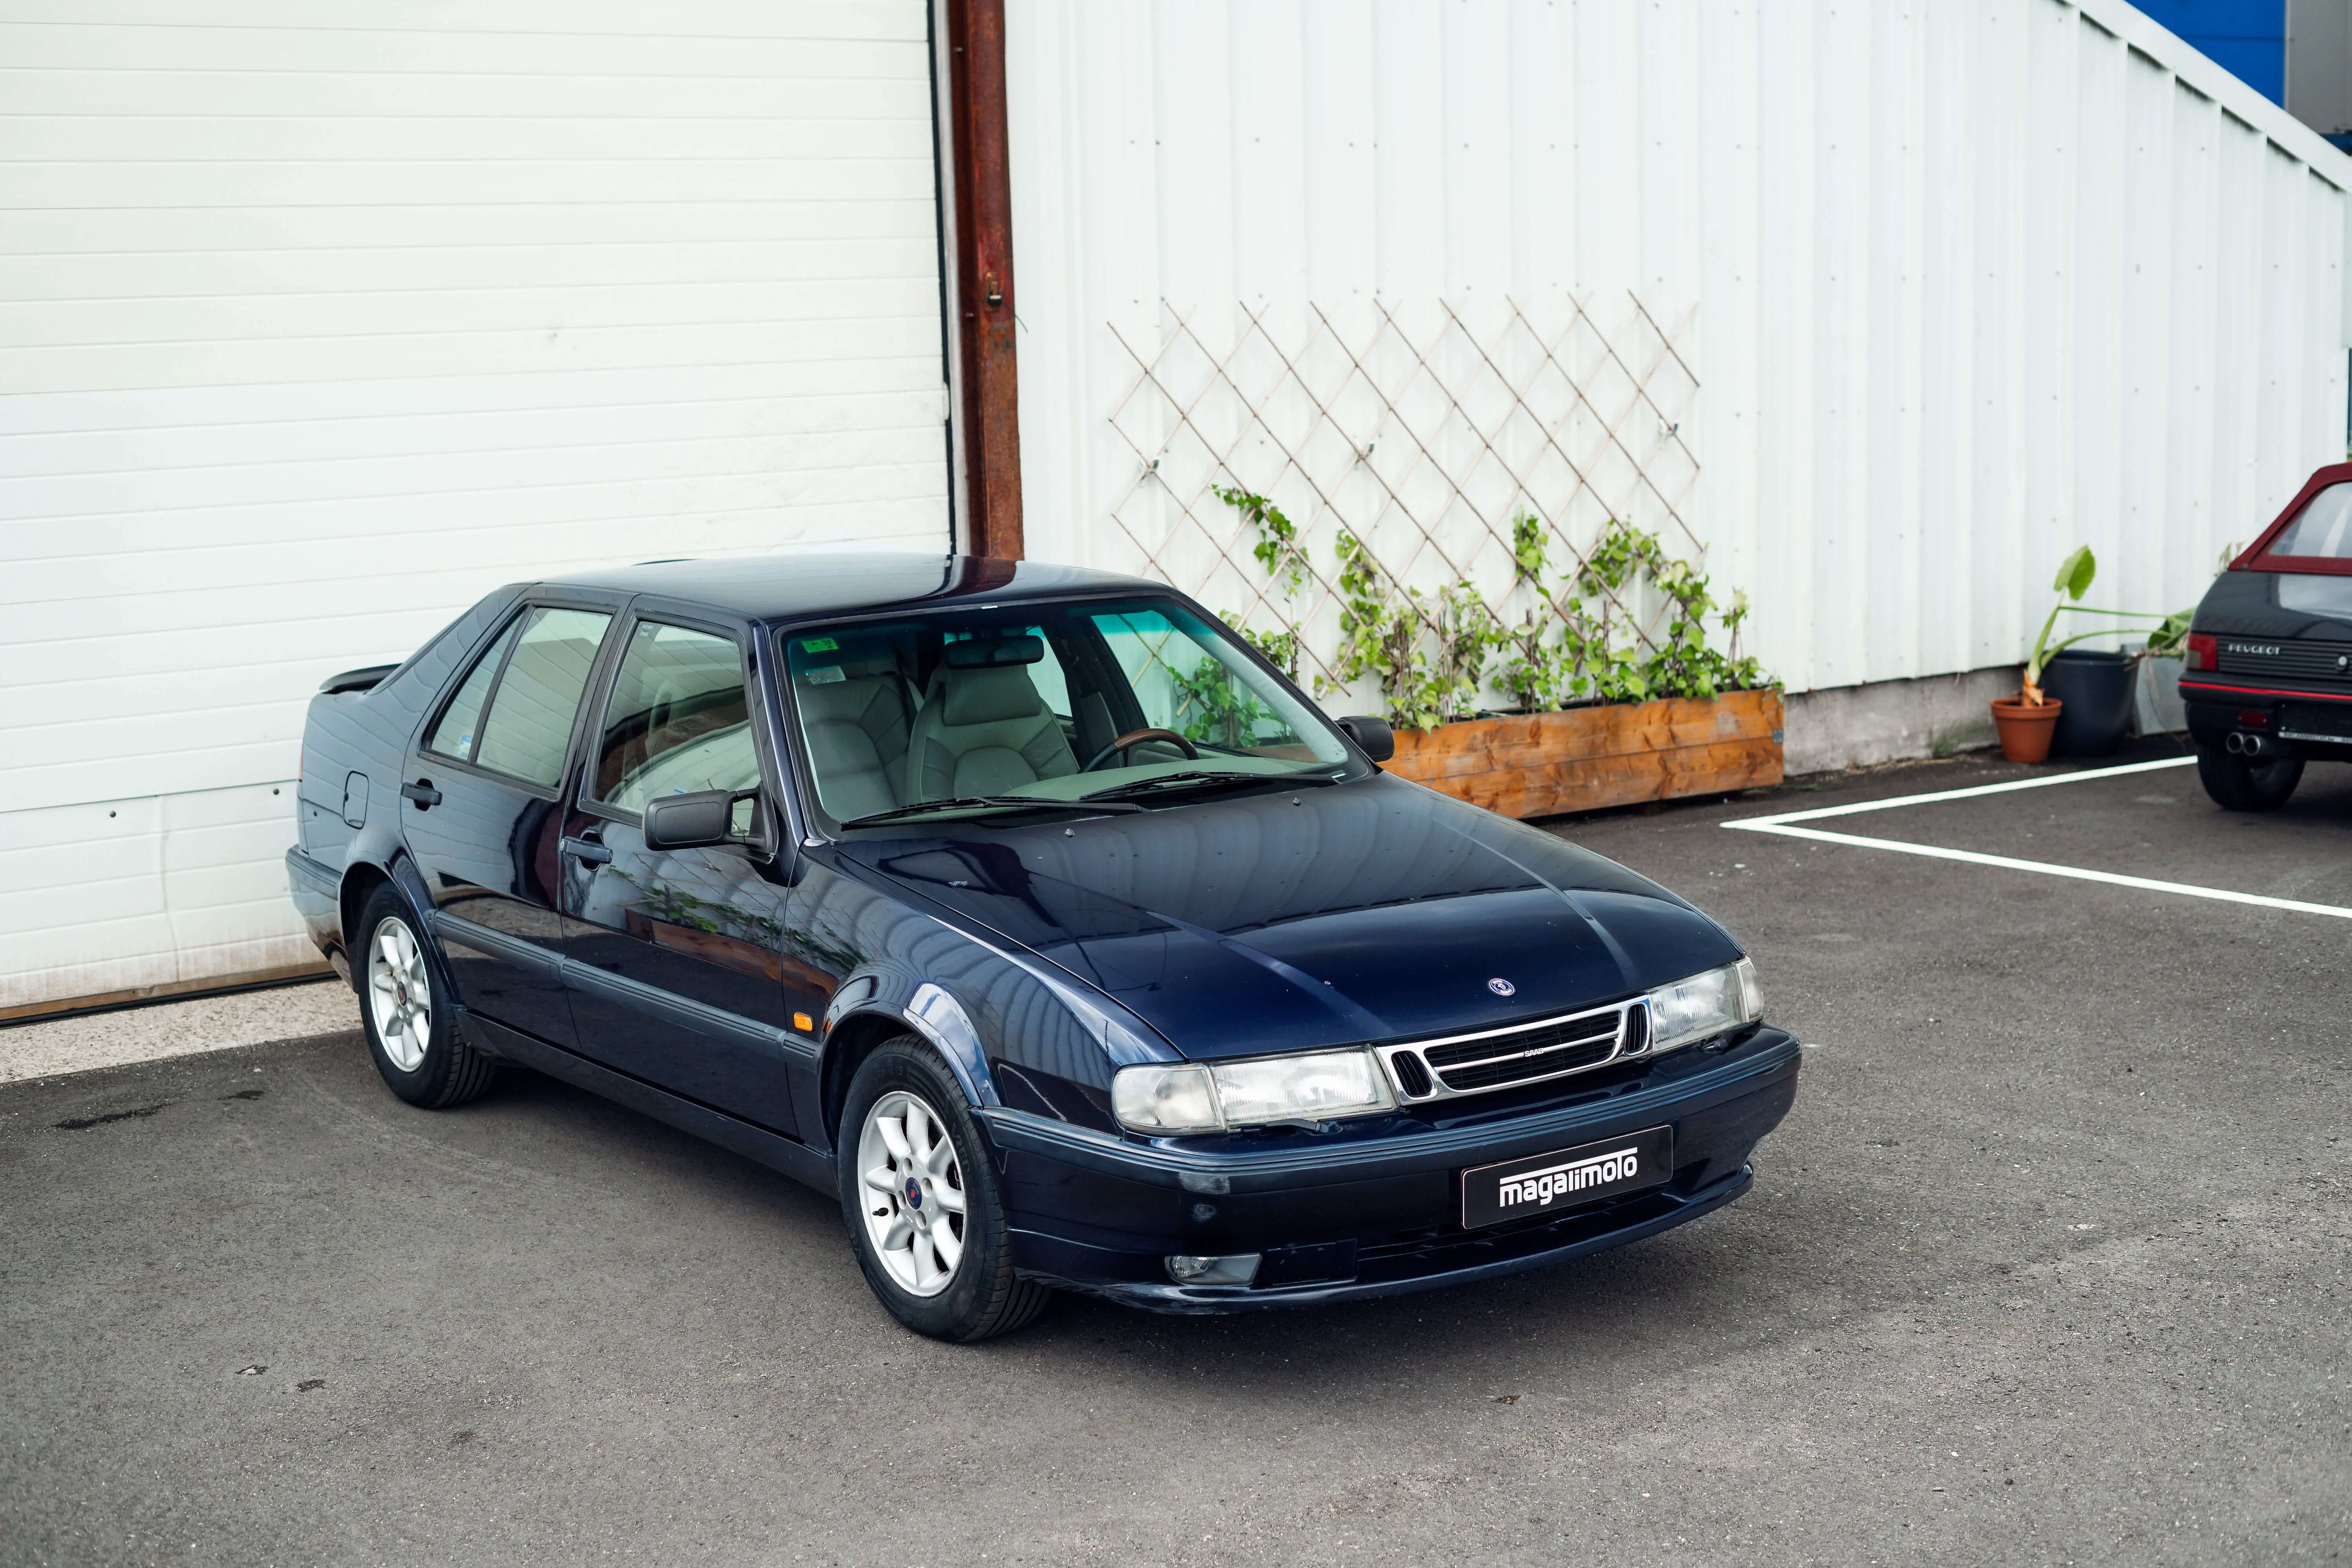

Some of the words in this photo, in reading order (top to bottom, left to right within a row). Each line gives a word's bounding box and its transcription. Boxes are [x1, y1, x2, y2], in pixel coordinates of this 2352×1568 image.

[2228, 643, 2280, 655] PEUGEOT
[1524, 1048, 1544, 1057] SAAB
[1500, 1147, 1637, 1207] magalimoto
